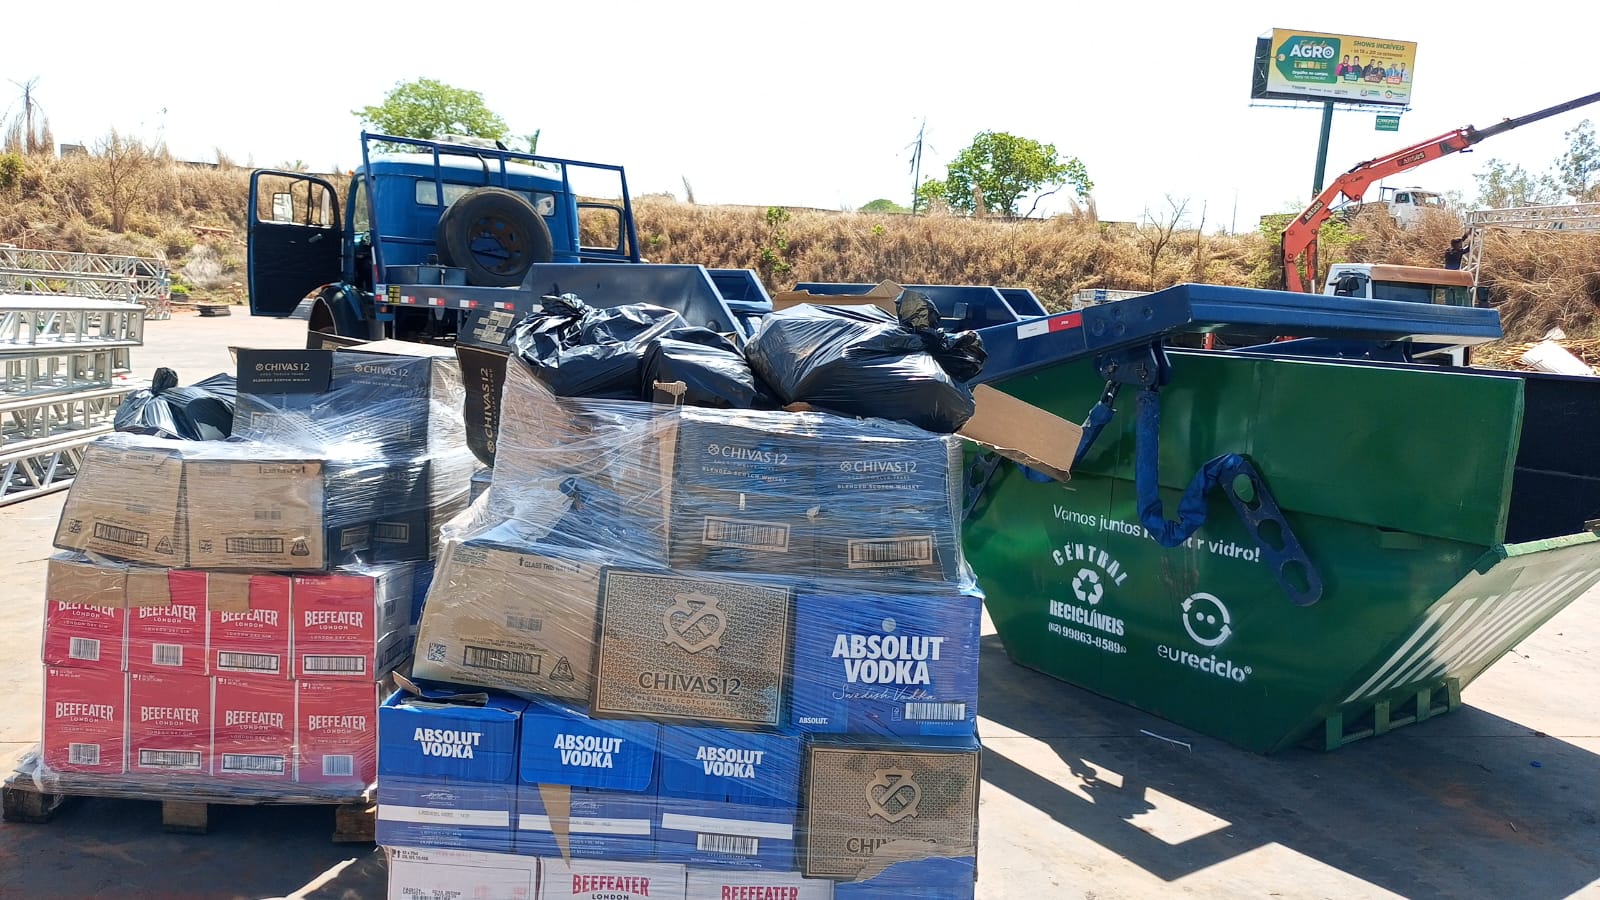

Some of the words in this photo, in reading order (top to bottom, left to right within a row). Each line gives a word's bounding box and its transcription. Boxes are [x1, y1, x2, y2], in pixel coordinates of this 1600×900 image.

[1290, 44, 1334, 58] AGRO
[265, 362, 298, 372] CHIVAS
[300, 362, 310, 372] 12
[364, 364, 398, 376] CHIVAS
[400, 368, 408, 378] 12
[480, 368, 489, 382] 12
[482, 385, 494, 438] CHIVAS
[722, 446, 772, 463] CHIVAS
[774, 454, 788, 465] 12
[854, 461, 902, 473] CHIVAS
[904, 461, 917, 473] 12
[1053, 504, 1096, 526] Vamos
[1099, 514, 1140, 538] juntos
[1208, 540, 1260, 563] vidro!
[1052, 542, 1128, 586] CENTRAL
[139, 605, 196, 622] BEEFEATER
[221, 609, 278, 626] BEEFEATER
[304, 610, 364, 628] BEEFEATER
[1050, 600, 1124, 636] RECICLÁVEIS
[832, 634, 944, 660] ABSOLUT
[844, 660, 930, 684] VODKA
[638, 672, 719, 694] CHIVAS
[722, 678, 741, 696] 12
[832, 684, 892, 700] Swedish
[56, 702, 114, 722] BEEFEATER
[141, 706, 199, 724] BEEFEATER
[226, 710, 284, 729] BEEFEATER
[308, 714, 366, 732] BEEFEATER
[414, 728, 482, 746] ABSOLUT
[554, 734, 623, 754] ABSOLUT
[421, 742, 474, 759] VODKA
[560, 750, 613, 768] VODKA
[696, 746, 764, 764] ABSOLUT
[703, 760, 755, 778] VODKA
[572, 874, 650, 896] BEEFEATER
[722, 885, 798, 900] BEEFEATER
